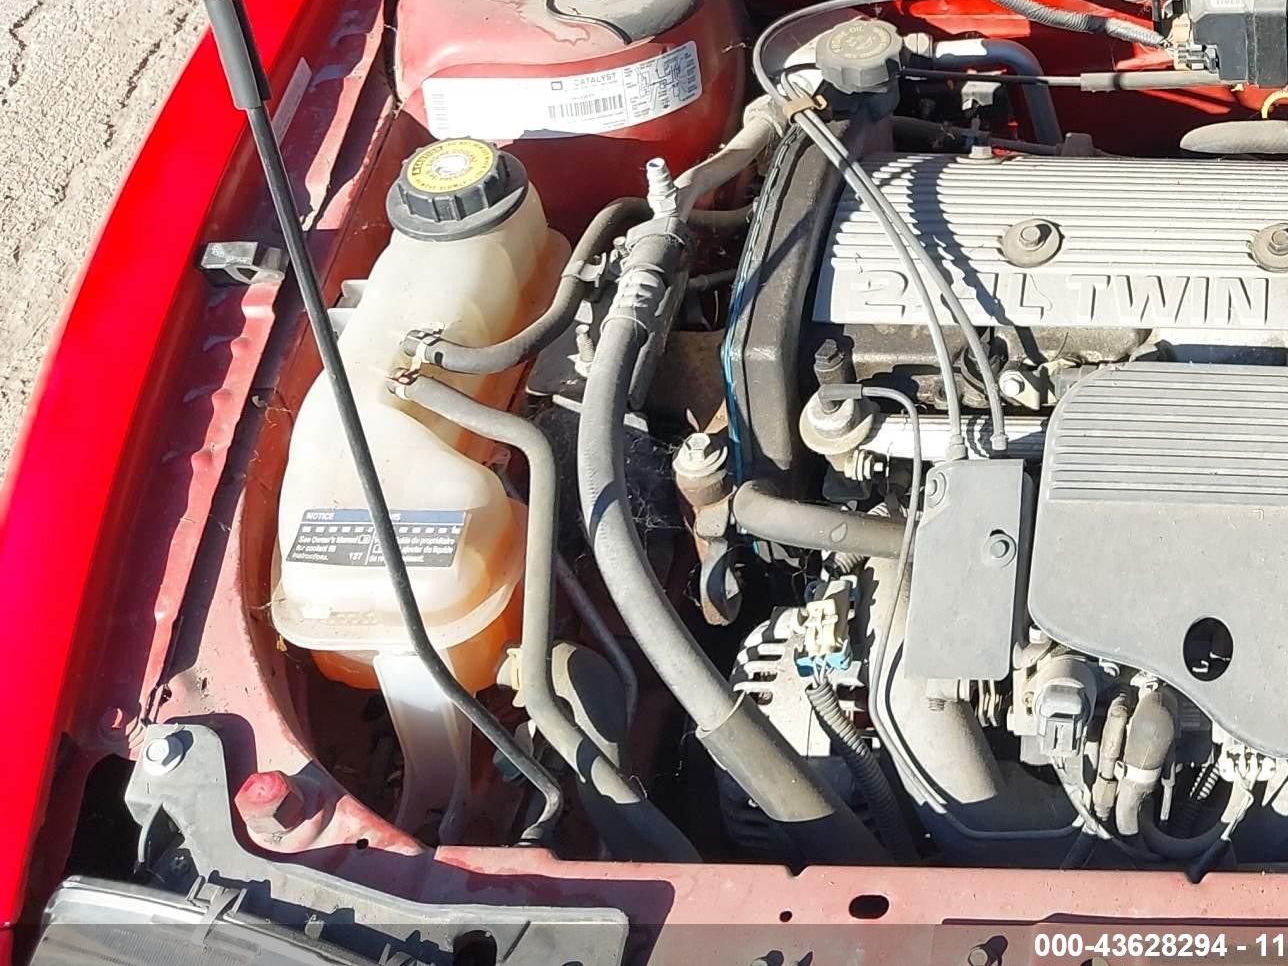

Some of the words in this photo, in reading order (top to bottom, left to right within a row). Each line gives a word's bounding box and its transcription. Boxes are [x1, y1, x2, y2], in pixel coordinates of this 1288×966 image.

[573, 72, 618, 86] CATALYST
[1067, 273, 1274, 324] TWIN
[306, 512, 335, 521] NOTICE
[298, 535, 311, 543] See
[311, 535, 336, 544] Owner's
